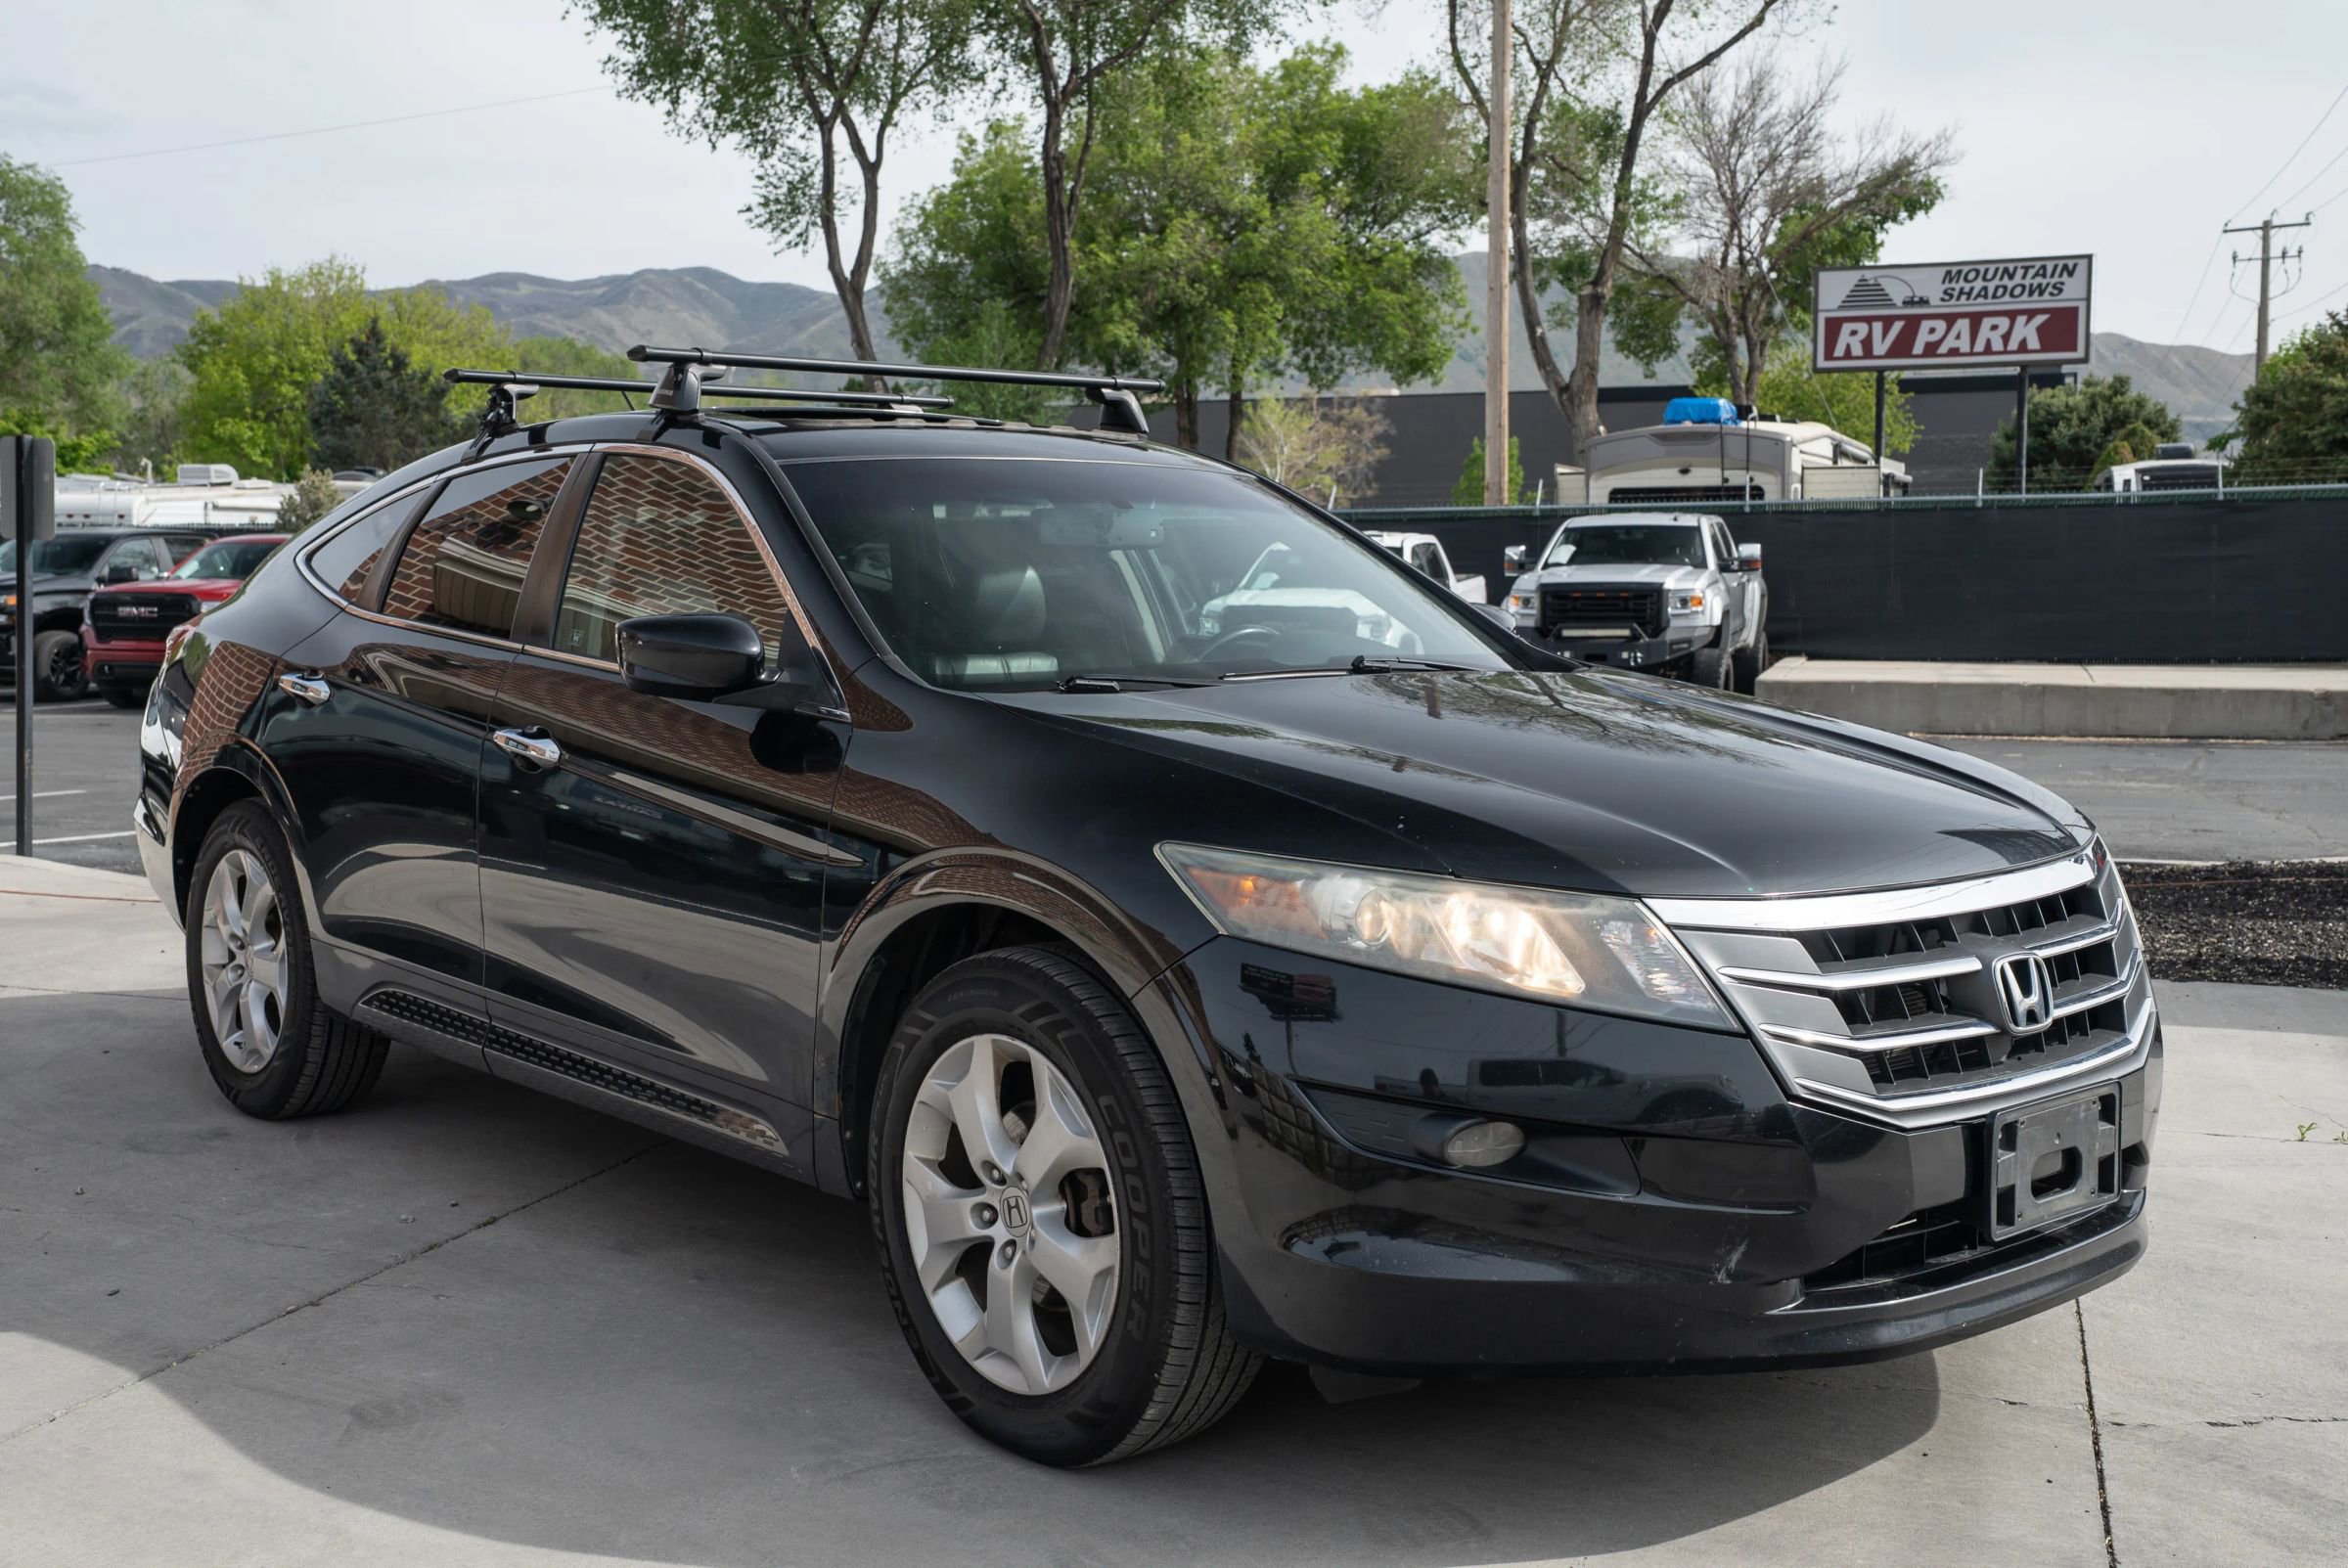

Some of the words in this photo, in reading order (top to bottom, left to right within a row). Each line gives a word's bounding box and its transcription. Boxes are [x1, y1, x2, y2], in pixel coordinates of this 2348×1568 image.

[1941, 262, 2078, 285] MOUNTAIN
[1940, 281, 2065, 302] SHADOWS
[1832, 320, 1905, 358] RV
[1912, 313, 2051, 355] PARK
[117, 606, 158, 617] GMC
[1098, 1095, 1151, 1342] COOPER
